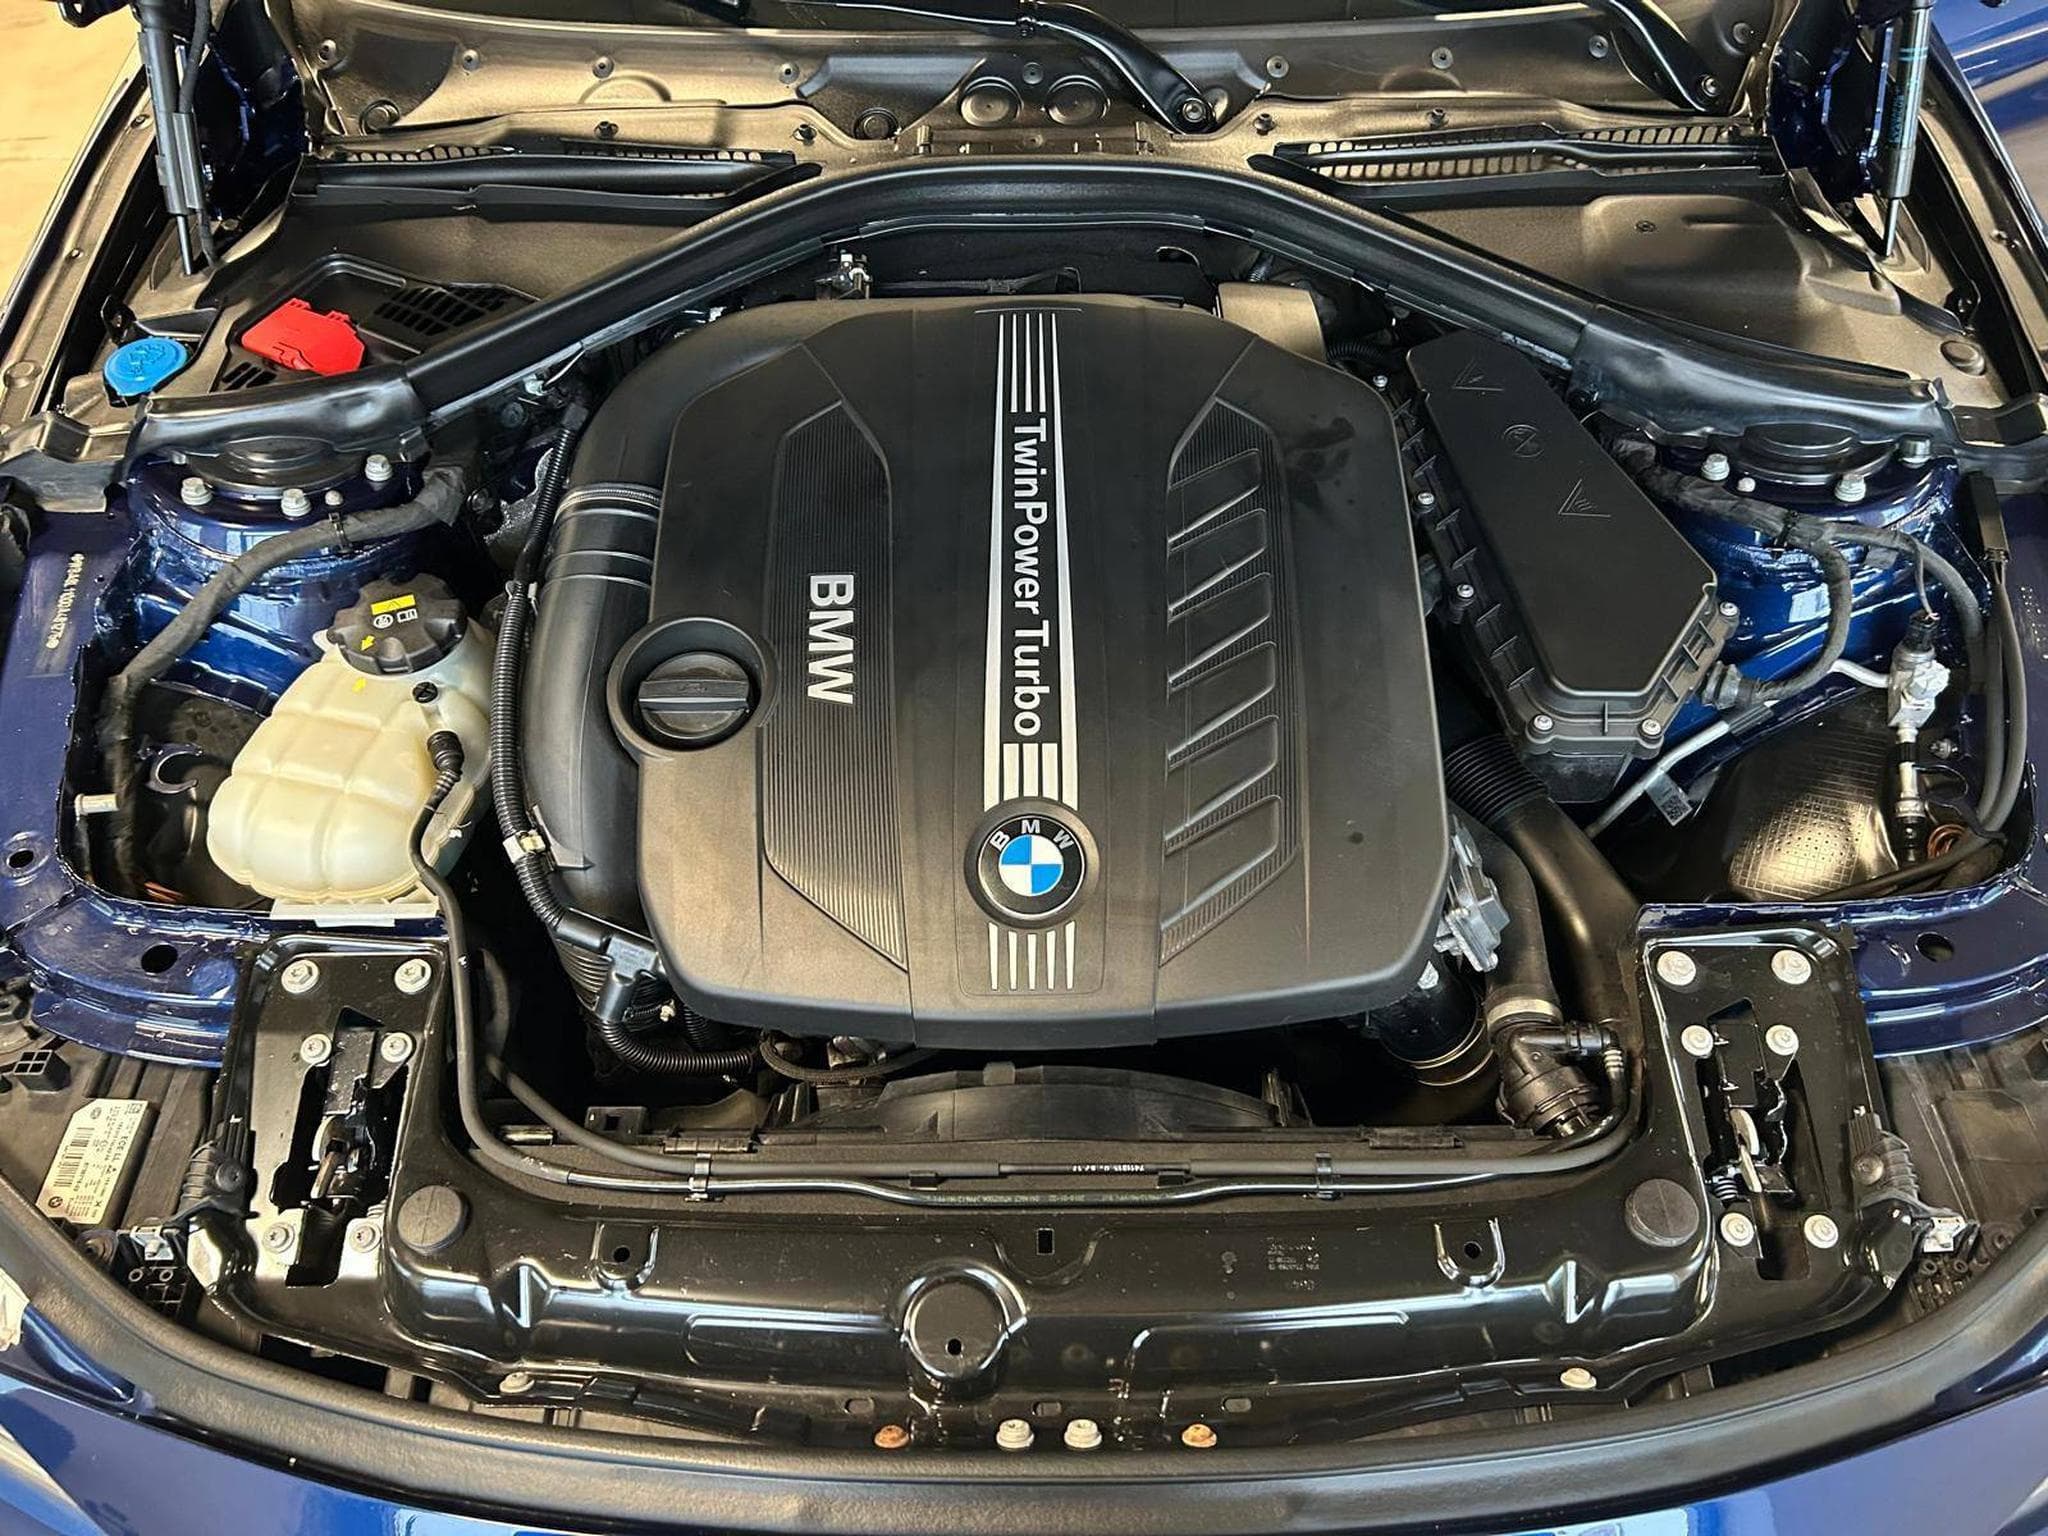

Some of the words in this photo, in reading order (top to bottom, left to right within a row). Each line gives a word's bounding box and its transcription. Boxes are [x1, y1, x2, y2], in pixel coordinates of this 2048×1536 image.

[1013, 418, 1048, 616] TwinPower
[807, 574, 855, 705] BMW
[1013, 619, 1051, 737] Turbo
[989, 819, 1075, 852] BMW
